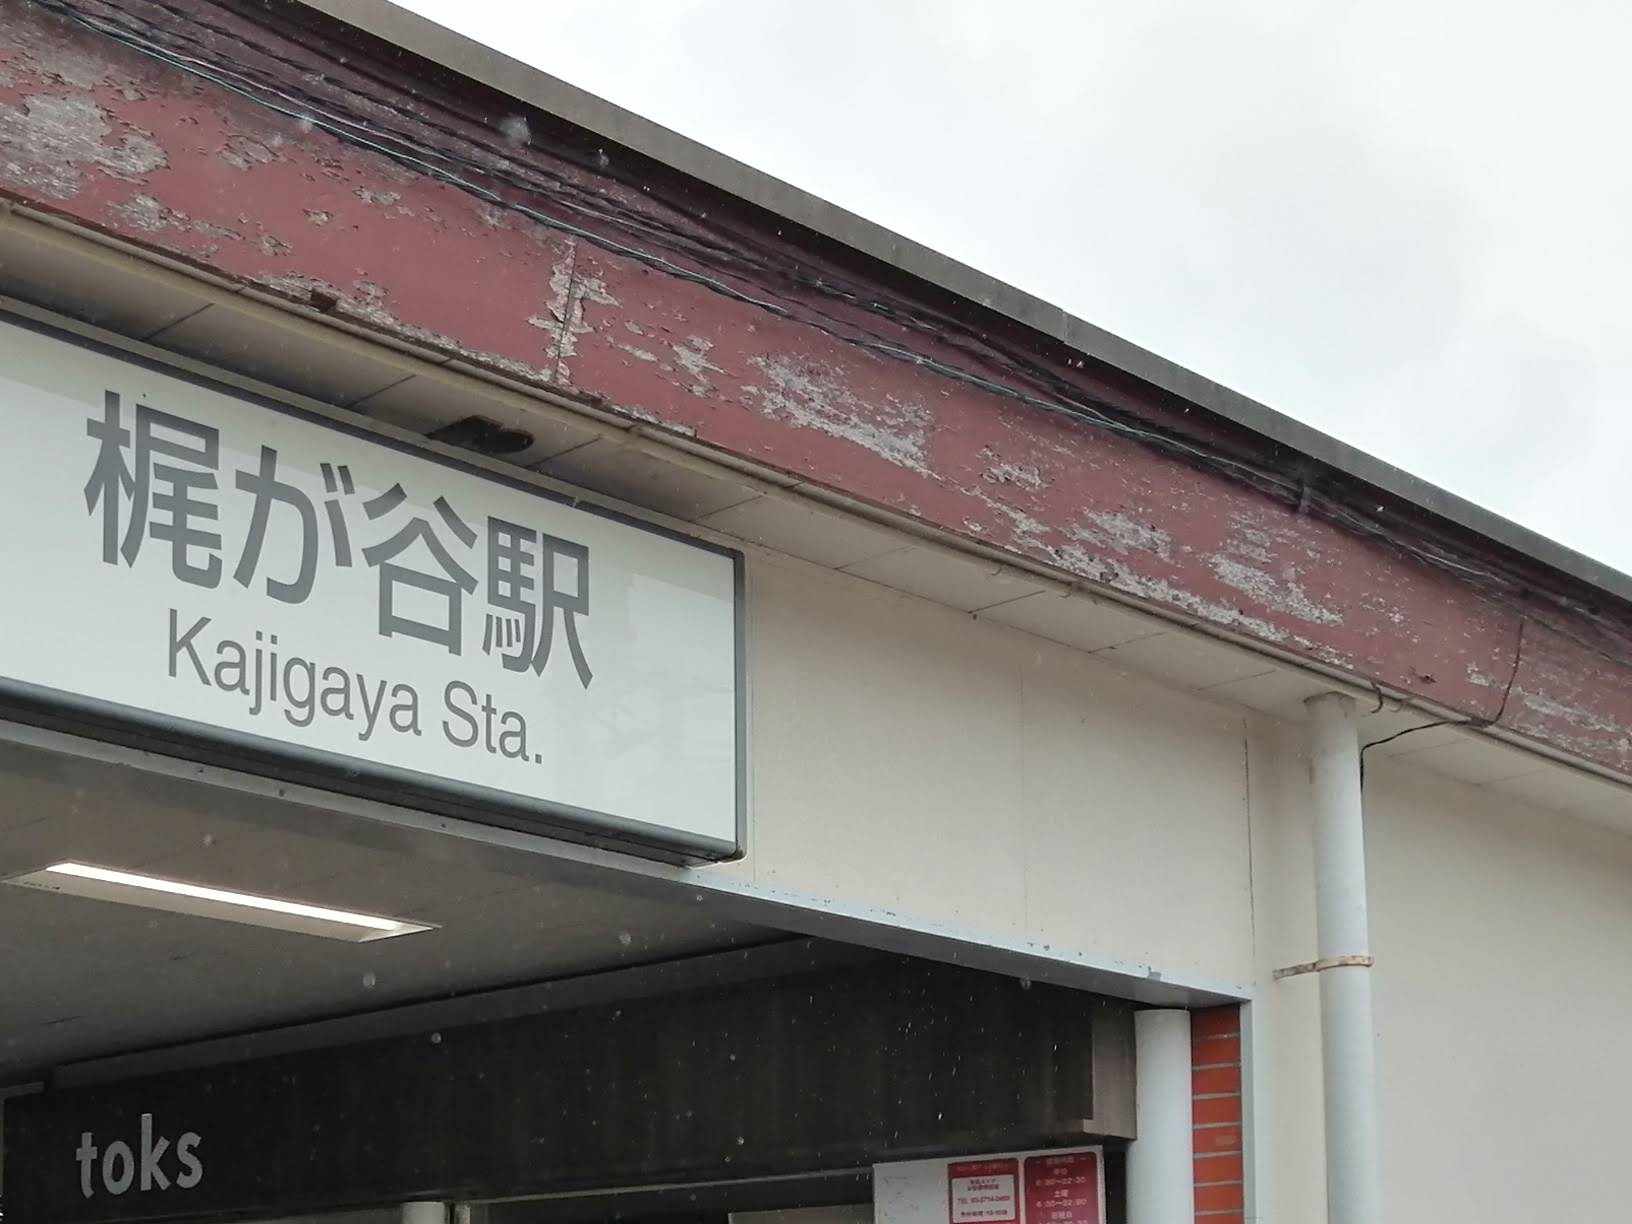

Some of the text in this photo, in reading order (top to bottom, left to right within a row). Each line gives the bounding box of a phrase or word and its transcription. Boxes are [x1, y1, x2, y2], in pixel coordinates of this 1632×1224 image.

[83, 390, 594, 690] 梶が谷駅
[167, 607, 543, 764] Kajigaya Sta.
[75, 1112, 204, 1199] toks
